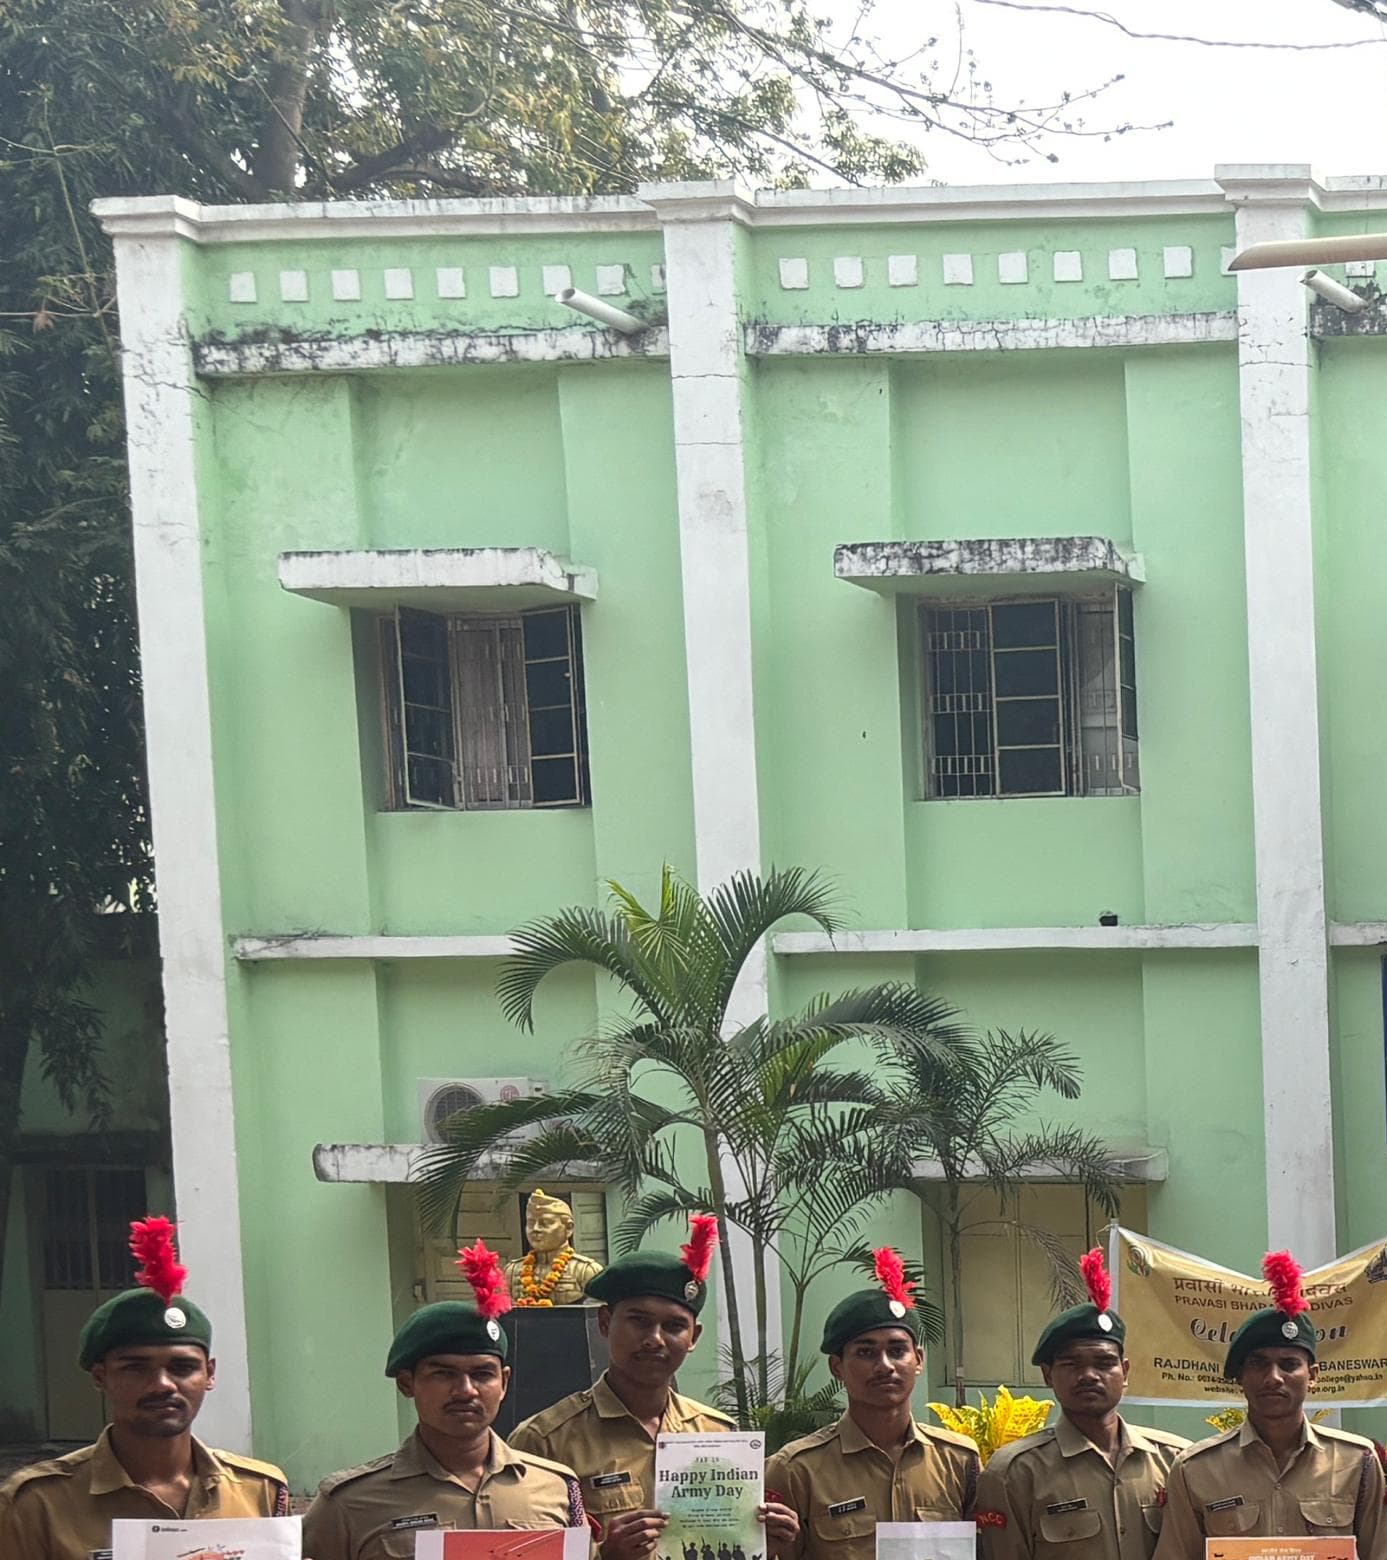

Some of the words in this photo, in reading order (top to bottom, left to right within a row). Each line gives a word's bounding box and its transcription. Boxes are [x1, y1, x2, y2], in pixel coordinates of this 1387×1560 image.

[1174, 1295, 1226, 1310] PRAVASI
[1310, 1296, 1354, 1312] DIVAS
[1153, 1357, 1220, 1374] RAJDHANI
[659, 1469, 707, 1485] Happy
[710, 1466, 759, 1481] Indian
[671, 1485, 712, 1500] Army
[716, 1484, 744, 1500] Day
